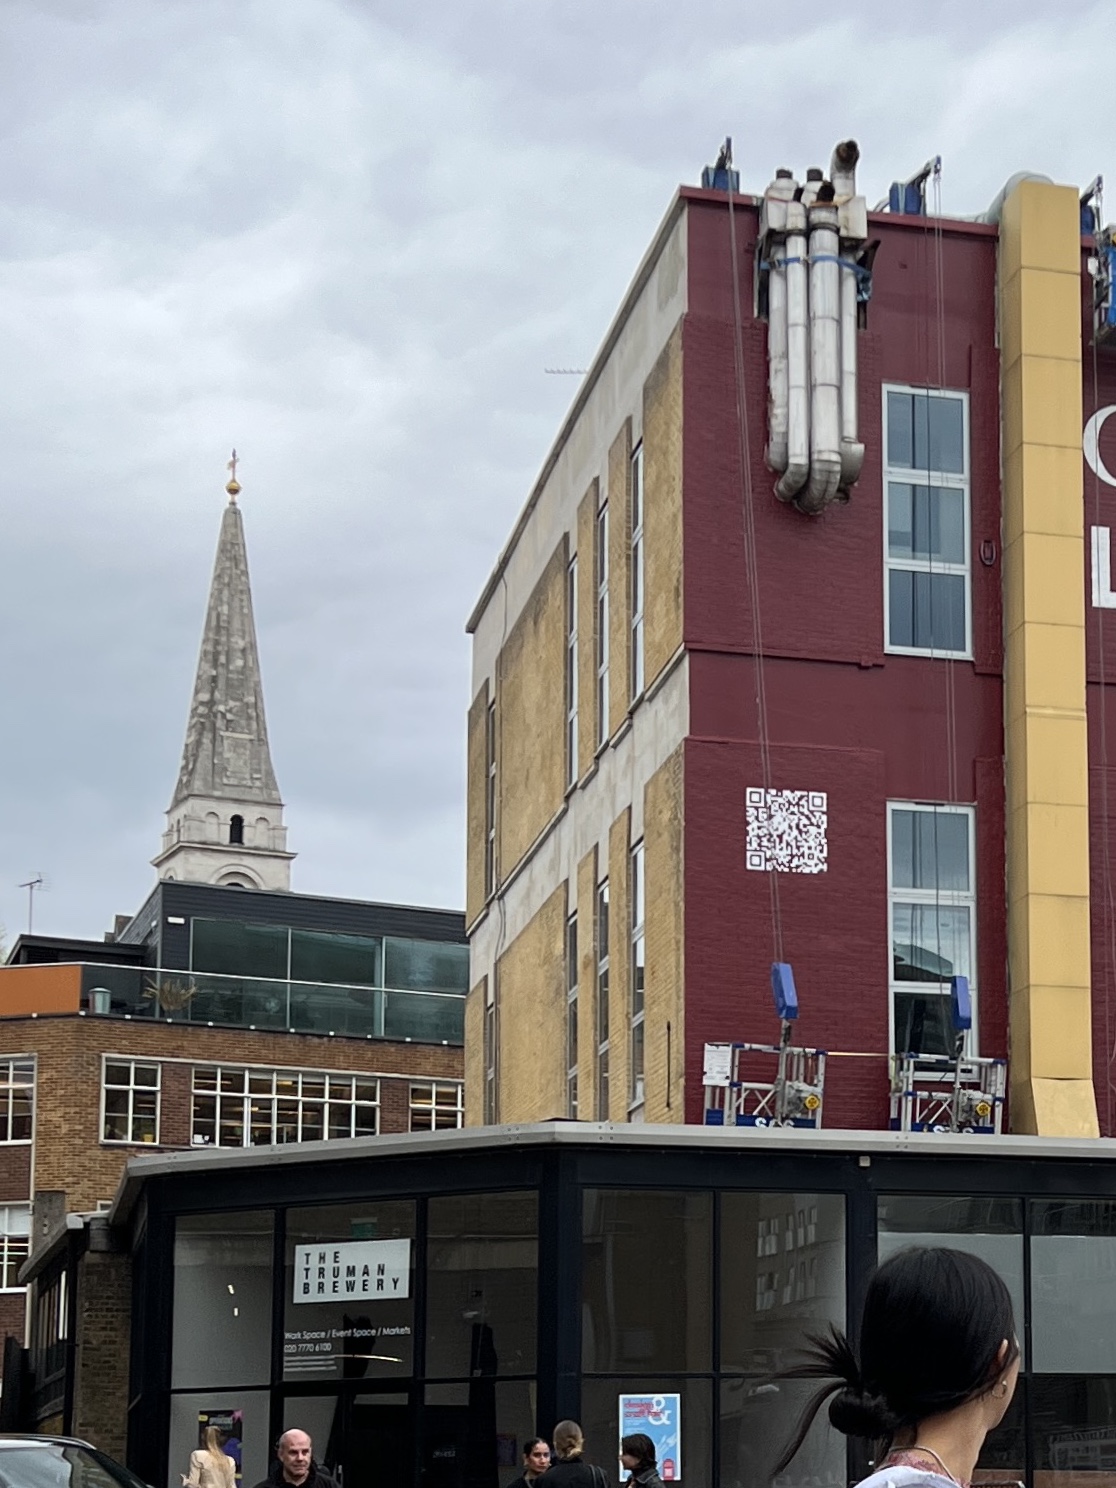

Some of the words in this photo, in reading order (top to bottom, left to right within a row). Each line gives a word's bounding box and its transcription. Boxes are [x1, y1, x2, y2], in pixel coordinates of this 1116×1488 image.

[304, 1251, 340, 1265] THE
[303, 1263, 385, 1280] TRUMAN
[302, 1277, 400, 1295] BREWERY
[284, 1331, 301, 1340] Work
[302, 1331, 326, 1340] Space
[332, 1329, 352, 1338] Event
[353, 1328, 376, 1338] Space
[382, 1326, 411, 1336] Markets
